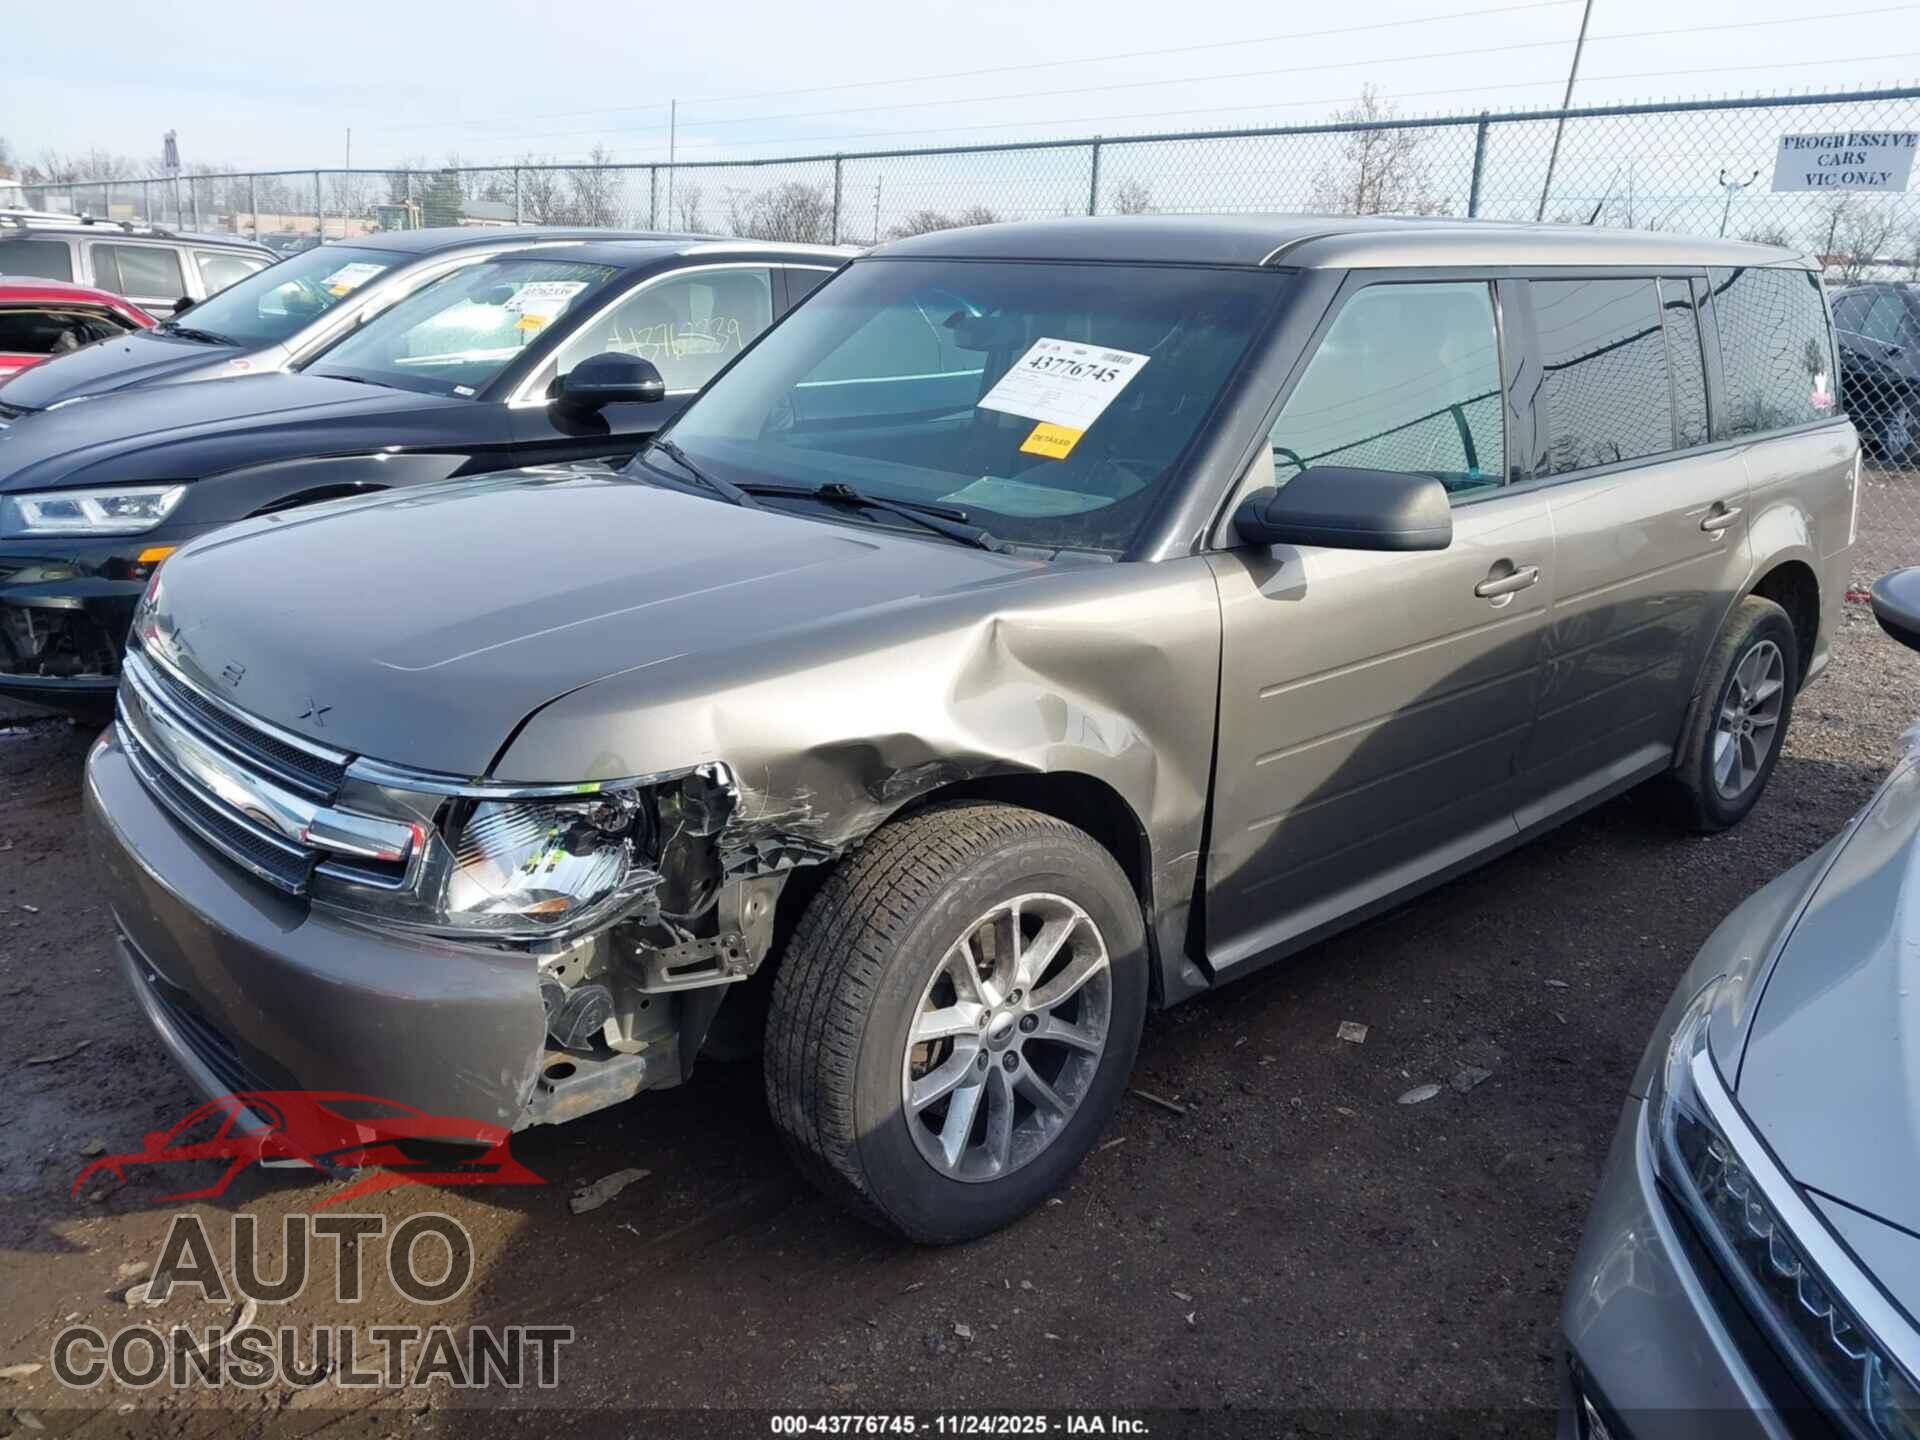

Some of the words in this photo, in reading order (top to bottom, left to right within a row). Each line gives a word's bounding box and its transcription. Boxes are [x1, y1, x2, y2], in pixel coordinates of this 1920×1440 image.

[1783, 133, 1918, 150] PROGRESSIVE
[1817, 151, 1867, 167] CARS
[1805, 173, 1837, 186] VIC
[1841, 171, 1893, 185] ONLY
[1029, 354, 1121, 383] 43776745
